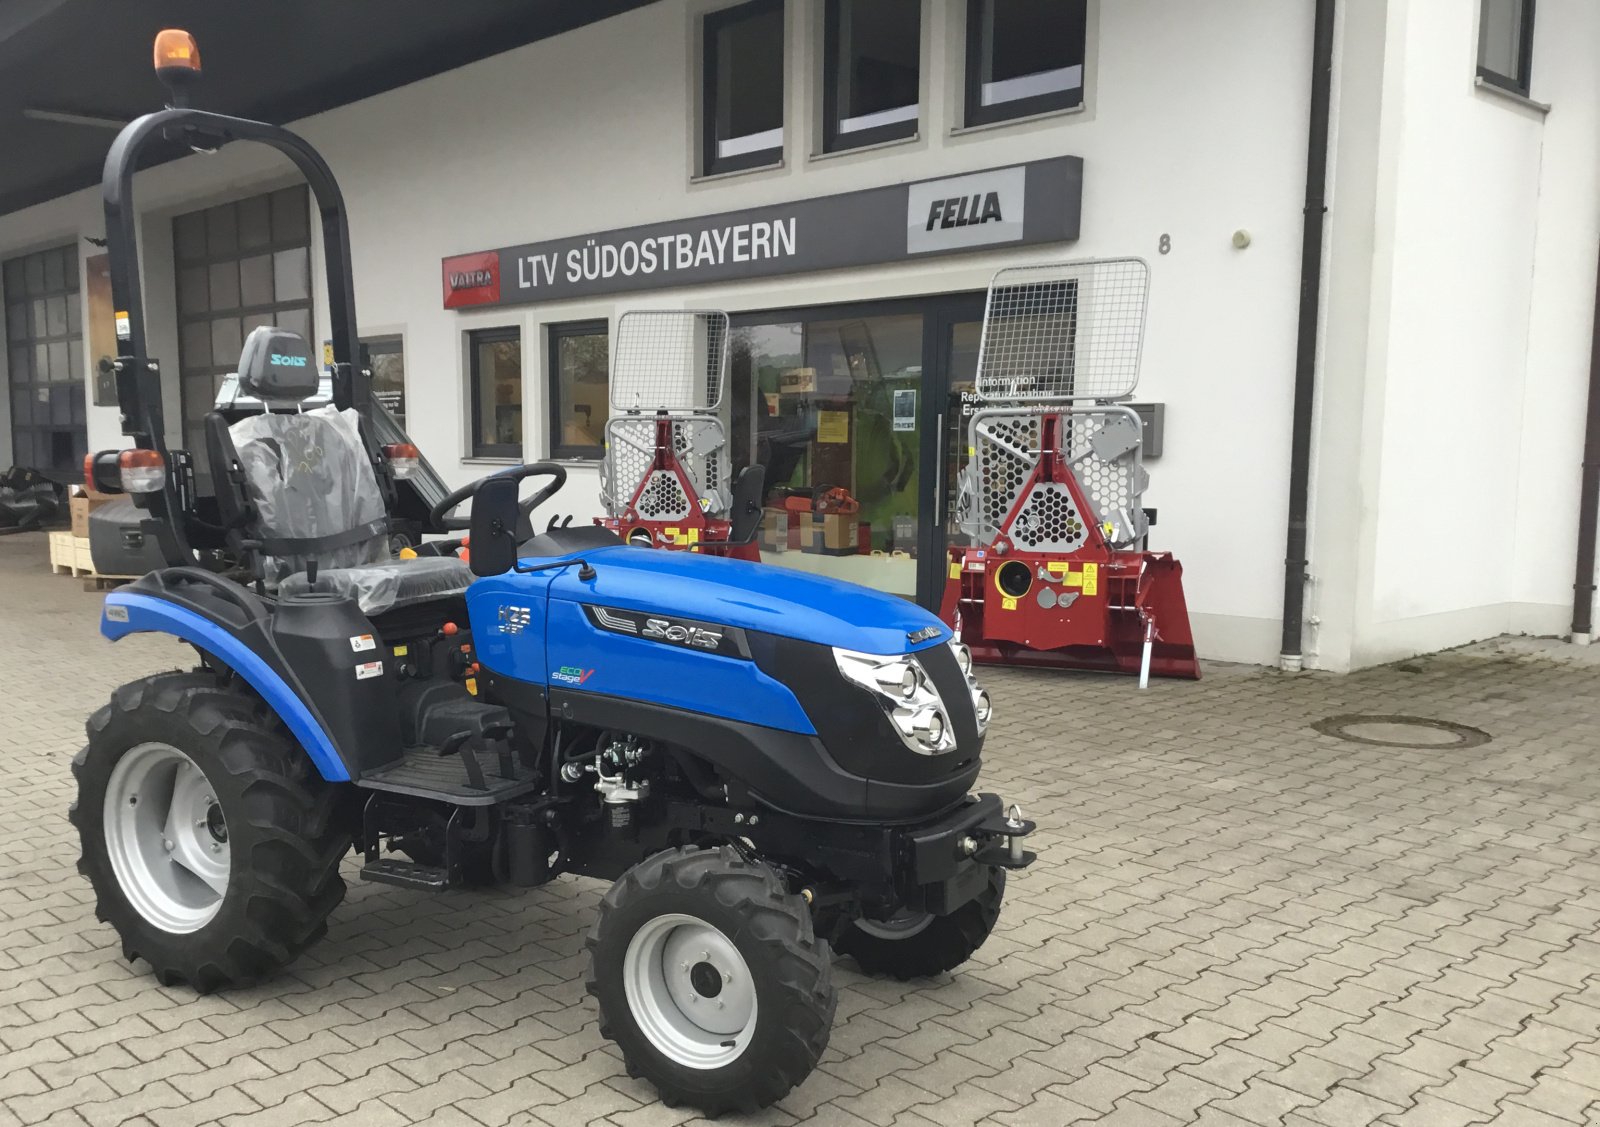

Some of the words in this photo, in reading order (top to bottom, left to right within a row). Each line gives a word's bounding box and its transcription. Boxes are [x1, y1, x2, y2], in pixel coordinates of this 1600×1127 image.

[926, 192, 1002, 231] FELLA
[518, 252, 558, 289] LTV
[566, 217, 797, 283] SÜDOSTBAYERN
[1158, 233, 1171, 255] 8
[449, 270, 494, 289] VALTRA
[560, 666, 582, 676] ECO
